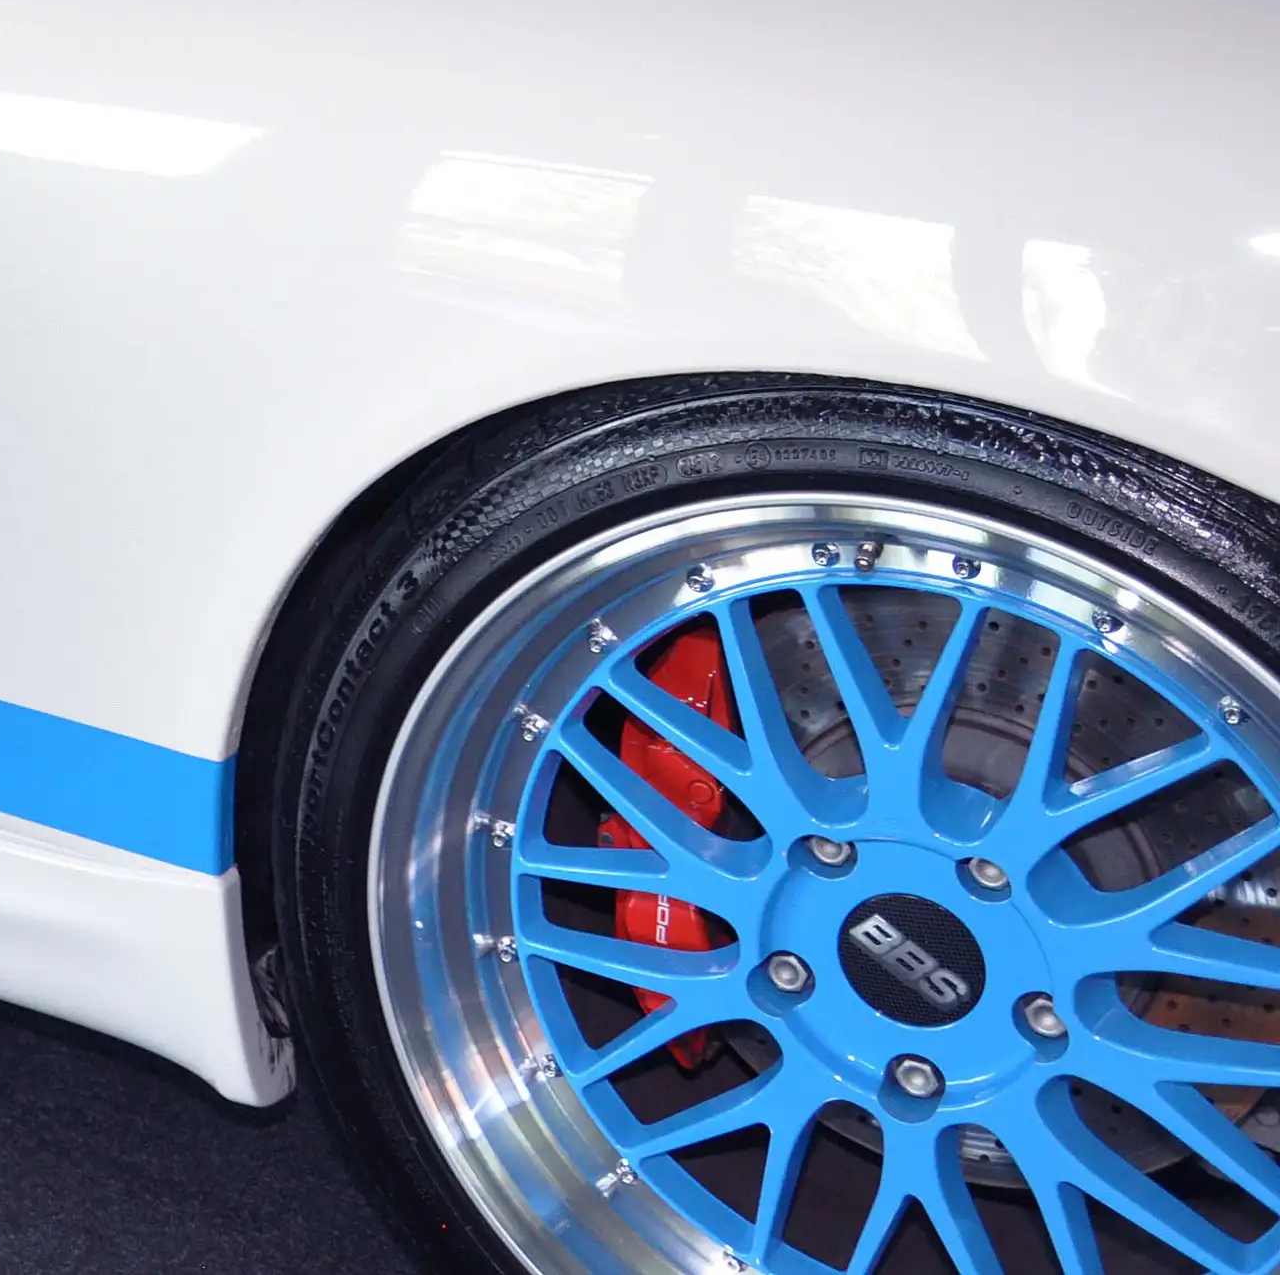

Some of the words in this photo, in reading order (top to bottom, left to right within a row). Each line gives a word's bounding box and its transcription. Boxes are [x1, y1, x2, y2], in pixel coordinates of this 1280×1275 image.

[1066, 501, 1159, 556] OUTSIDE
[397, 570, 420, 601] 3
[849, 914, 969, 1007] BBS
